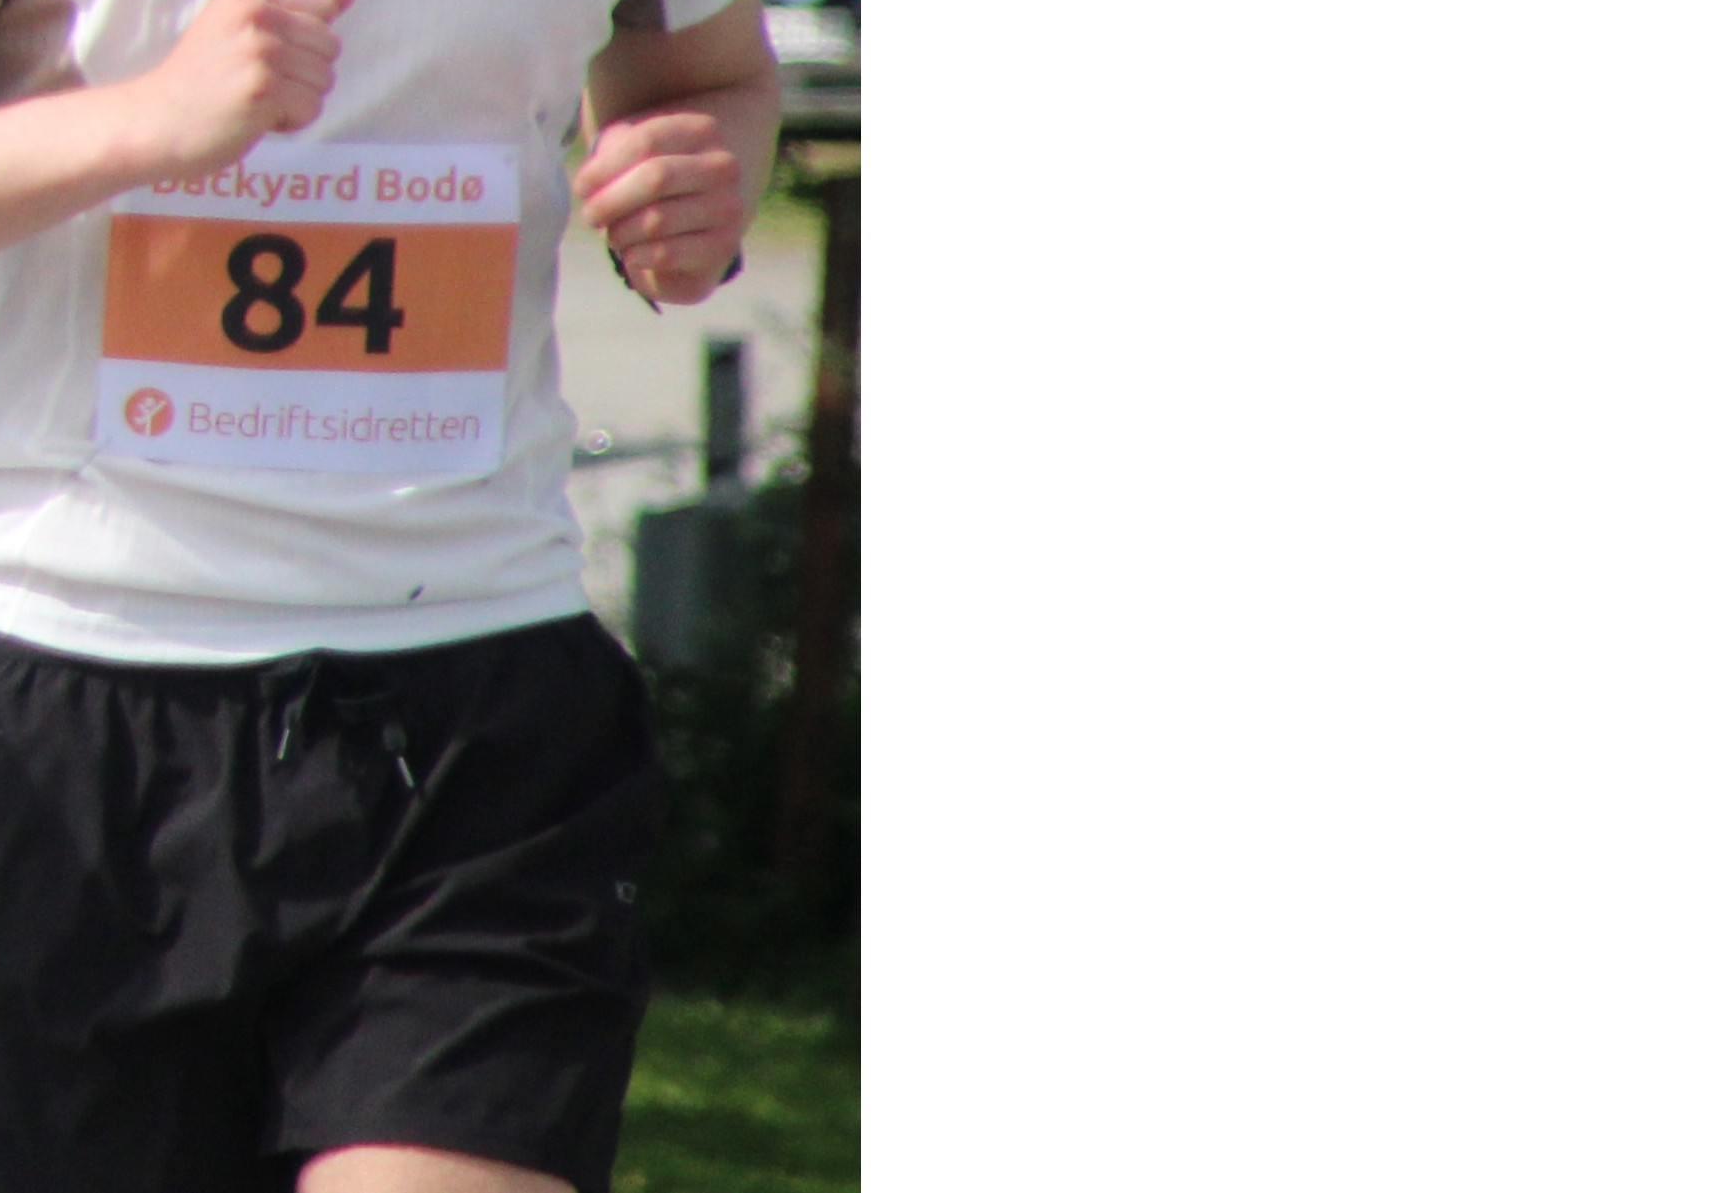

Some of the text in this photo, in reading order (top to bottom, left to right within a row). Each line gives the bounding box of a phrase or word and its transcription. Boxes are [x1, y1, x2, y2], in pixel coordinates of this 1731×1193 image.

[374, 165, 485, 204] Bodø
[221, 233, 405, 354] 84
[189, 401, 481, 443] Bedriftsidretten
